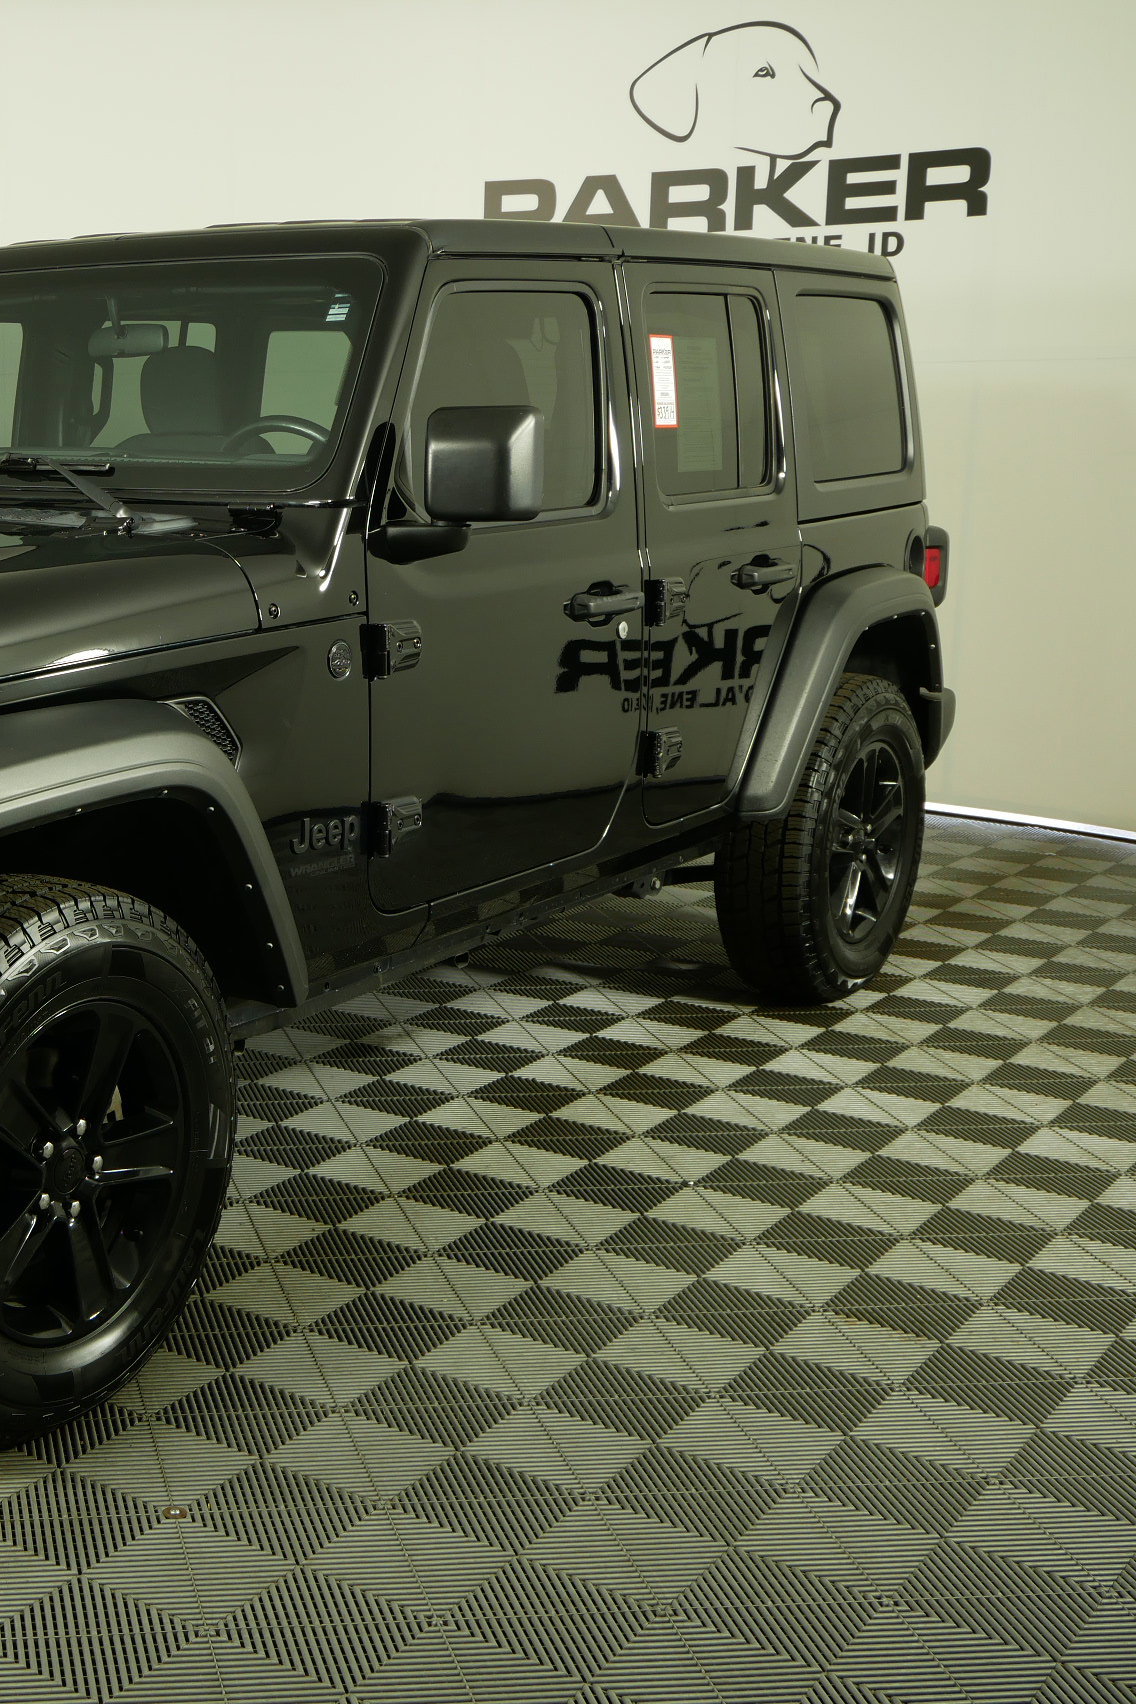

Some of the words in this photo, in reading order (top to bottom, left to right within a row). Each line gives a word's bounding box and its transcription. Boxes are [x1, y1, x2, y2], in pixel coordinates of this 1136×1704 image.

[484, 147, 992, 233] PARKER
[868, 232, 905, 257] ID
[290, 815, 360, 854] Jeep
